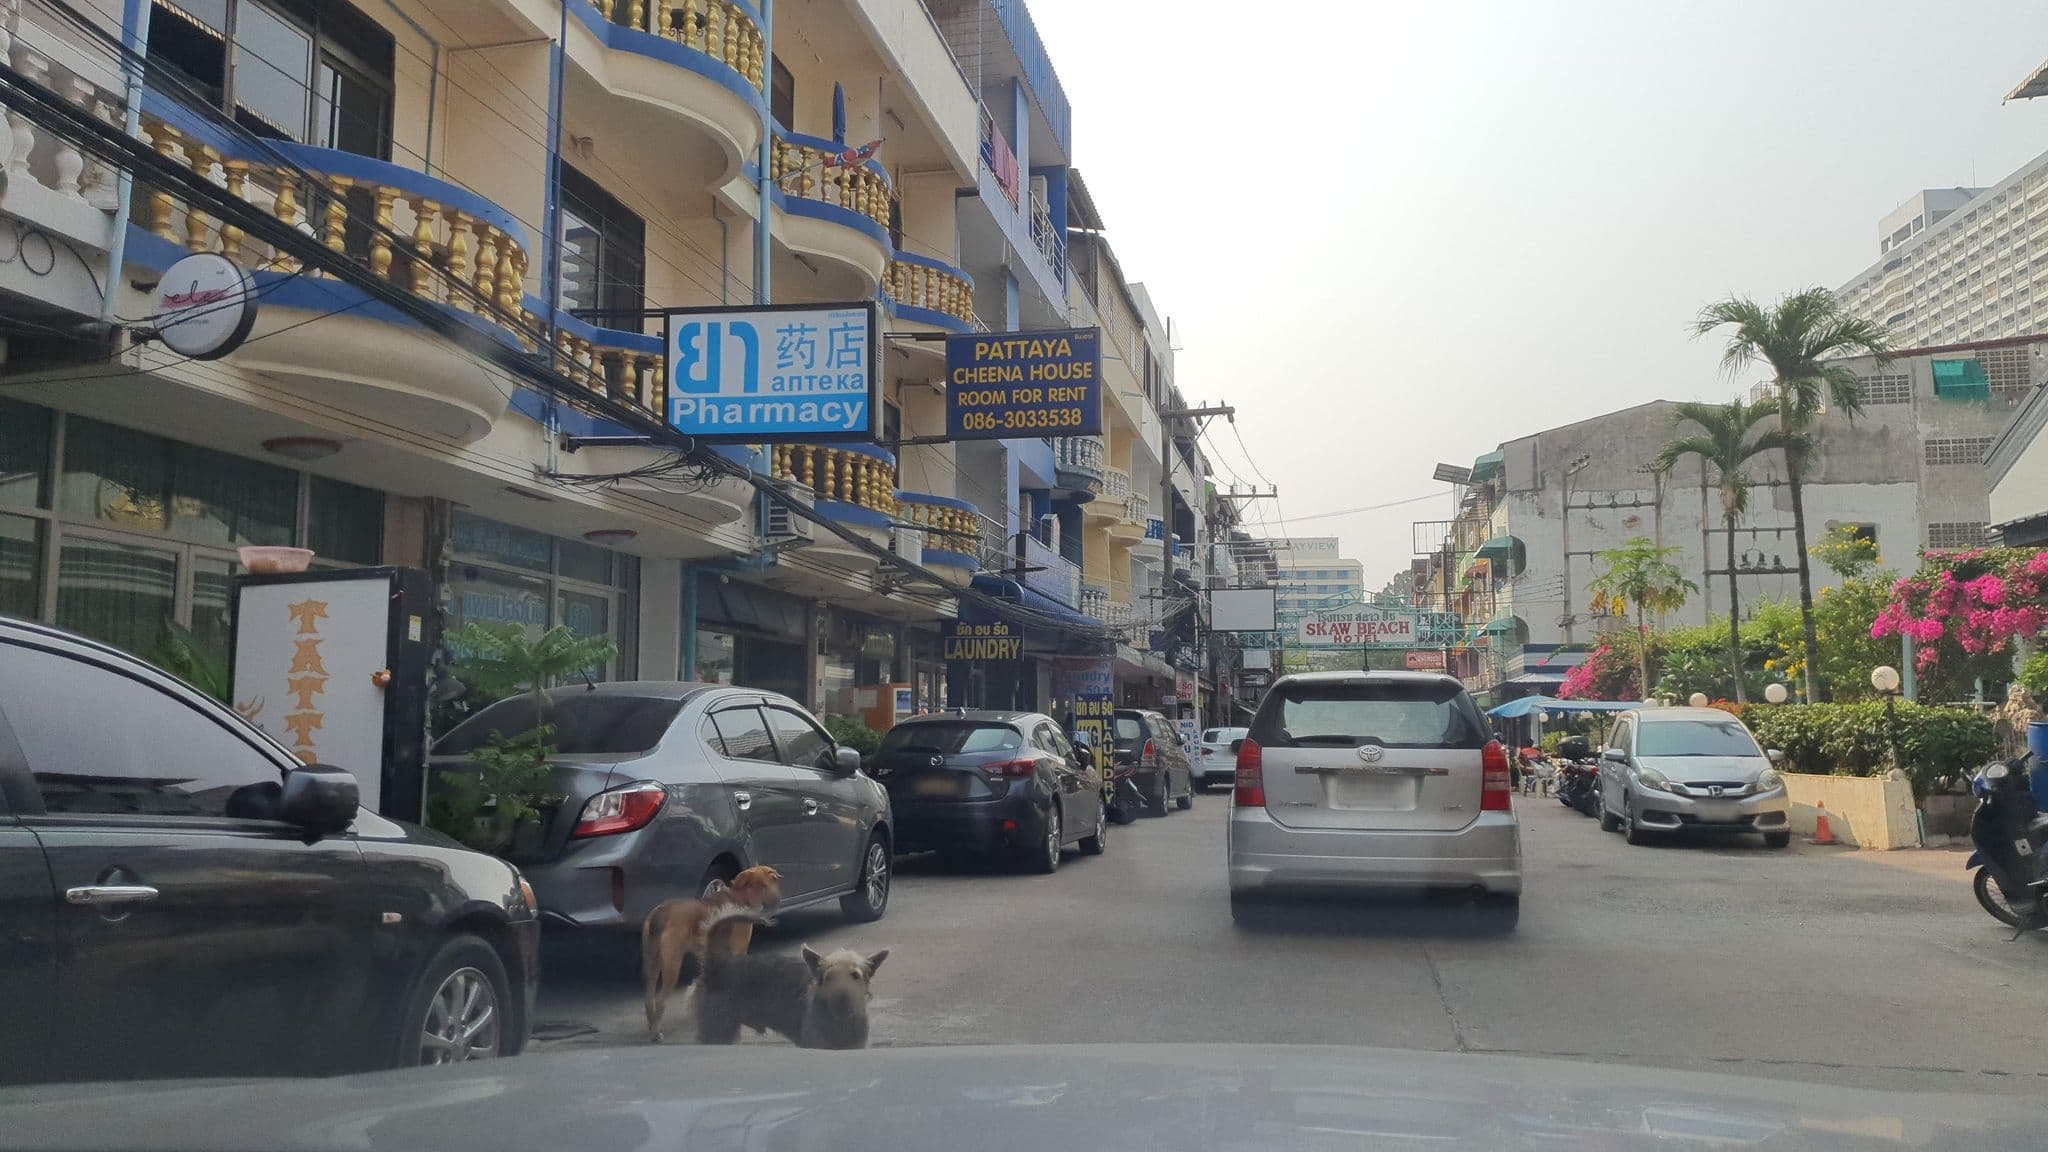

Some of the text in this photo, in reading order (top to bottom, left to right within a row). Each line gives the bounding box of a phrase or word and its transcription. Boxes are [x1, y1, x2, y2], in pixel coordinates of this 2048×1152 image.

[776, 322, 865, 370] 药店
[975, 338, 1072, 361] PATTAYA
[675, 321, 759, 394] ยา
[771, 372, 864, 392] аптека
[953, 362, 1093, 385] CHEENA HOUSE
[958, 386, 1087, 407] ROOM FOR RENT
[674, 398, 863, 429] Pharmacy
[963, 408, 1082, 430] 086-3033538
[1290, 542, 1337, 551] AYVIEW
[1306, 622, 1351, 635] SKAW
[1356, 621, 1410, 635] BEACH
[1334, 635, 1381, 643] HOTEL
[944, 638, 1020, 660] LAUNDRY
[1103, 719, 1114, 804] LAUNDRY
